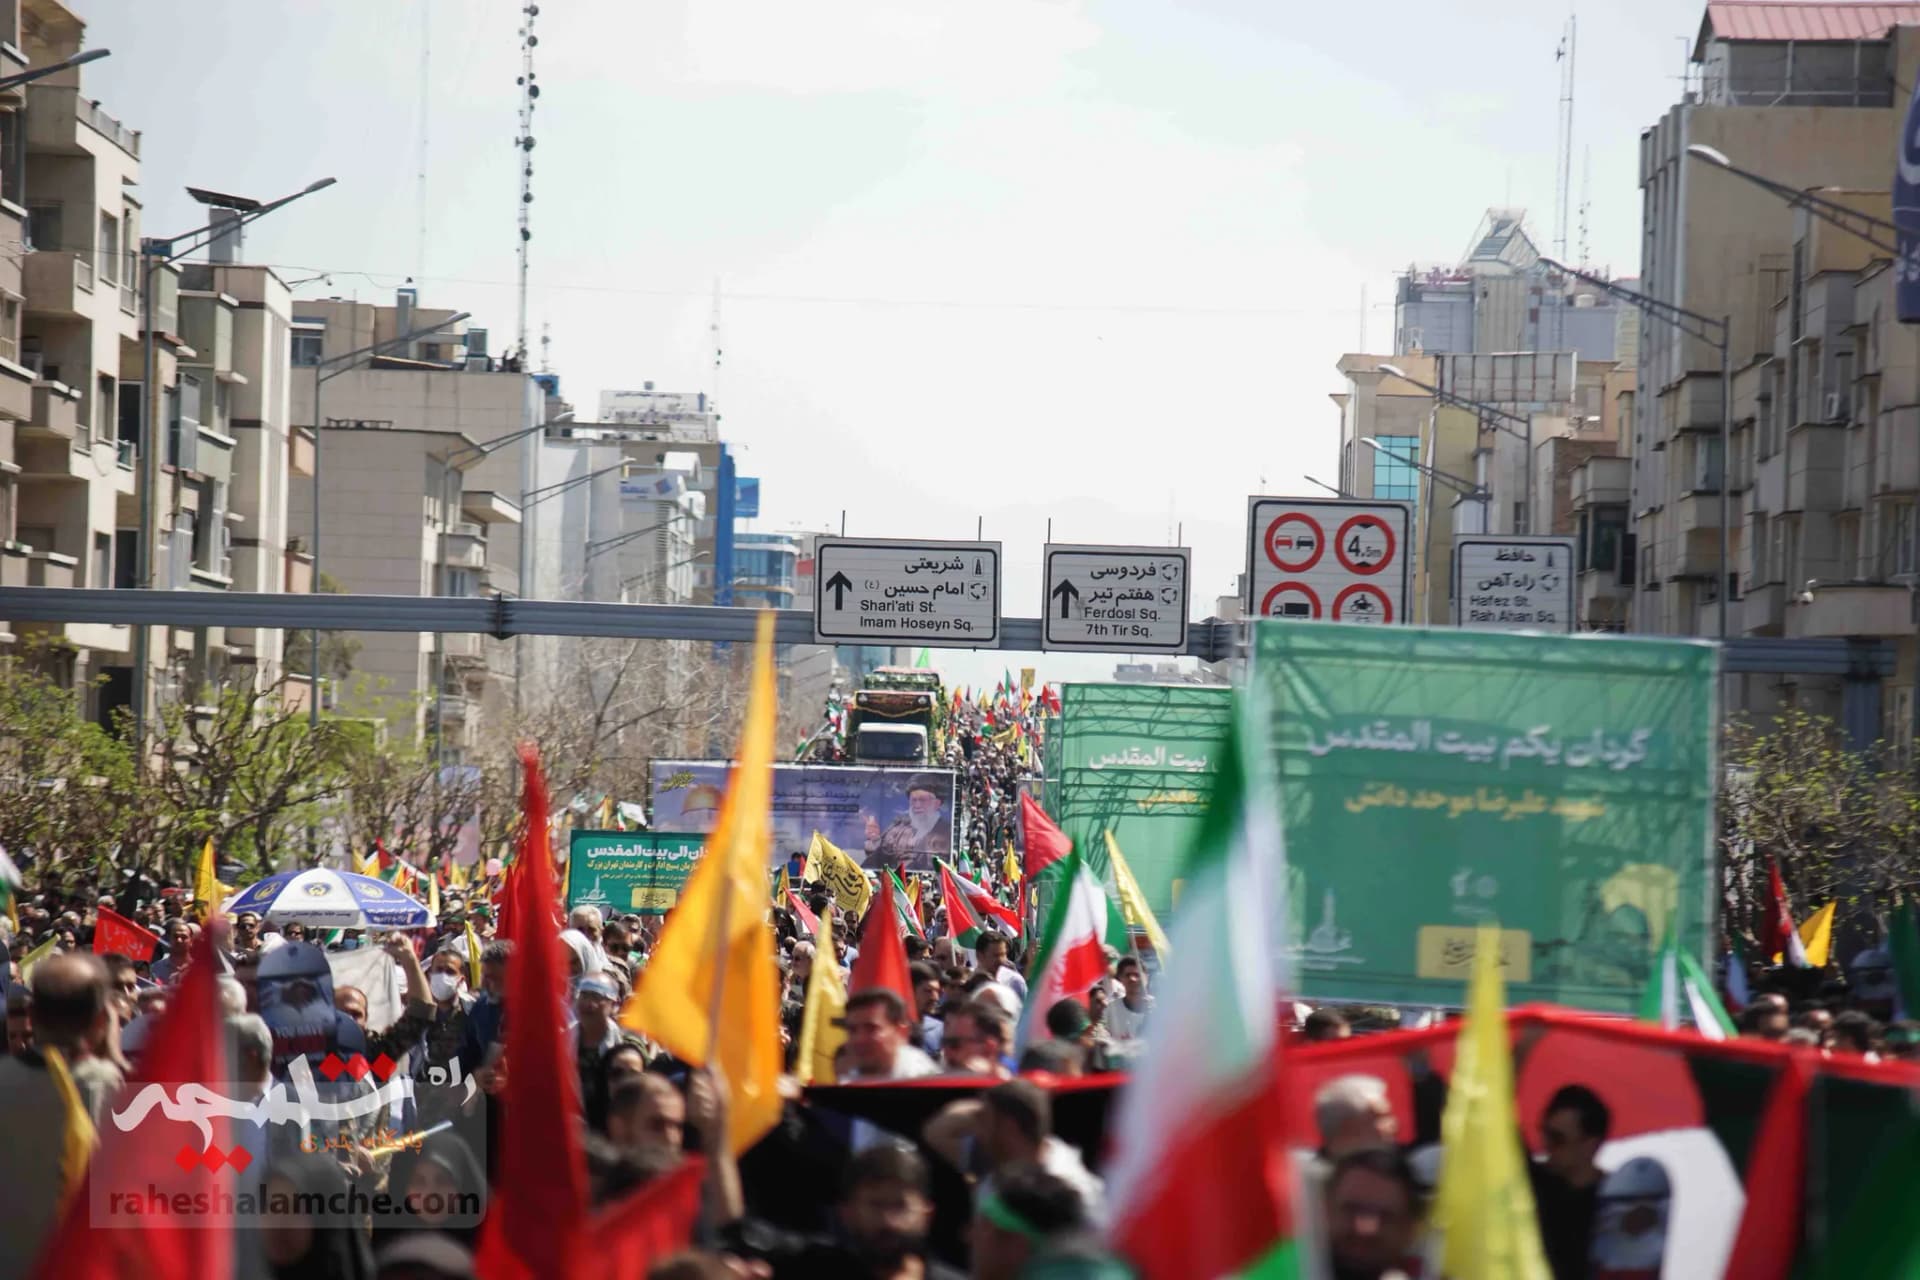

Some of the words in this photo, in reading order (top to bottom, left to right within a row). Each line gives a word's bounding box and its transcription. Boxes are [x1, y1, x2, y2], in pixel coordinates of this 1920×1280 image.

[1495, 548, 1536, 562] حافظ
[904, 556, 964, 574] شریعتی
[1090, 562, 1157, 580] فردوسی
[1478, 572, 1512, 591] آهن
[1513, 573, 1536, 591] راه
[884, 583, 929, 598] حسین
[933, 581, 964, 600] امام
[1088, 587, 1113, 603] تیر
[1115, 588, 1155, 607] هفتم
[919, 601, 936, 613] St.
[1470, 595, 1510, 607] Hafez
[1084, 606, 1136, 620] Ferdosi
[1139, 608, 1161, 622] Sq.
[1470, 609, 1496, 622] Rah
[859, 615, 897, 629] Imam
[900, 617, 950, 632] Hoseyn
[953, 618, 974, 632] Sq.
[1086, 623, 1108, 636] 7th
[1112, 624, 1128, 636] Tir
[1131, 625, 1153, 639] Sq.
[1308, 720, 1431, 756] المقدس
[1435, 731, 1497, 763] بیت
[1088, 746, 1166, 770] المقدس
[1168, 752, 1208, 773] بیت
[587, 844, 641, 858] المقدس
[642, 847, 668, 860] بیت
[668, 845, 689, 860] الی
